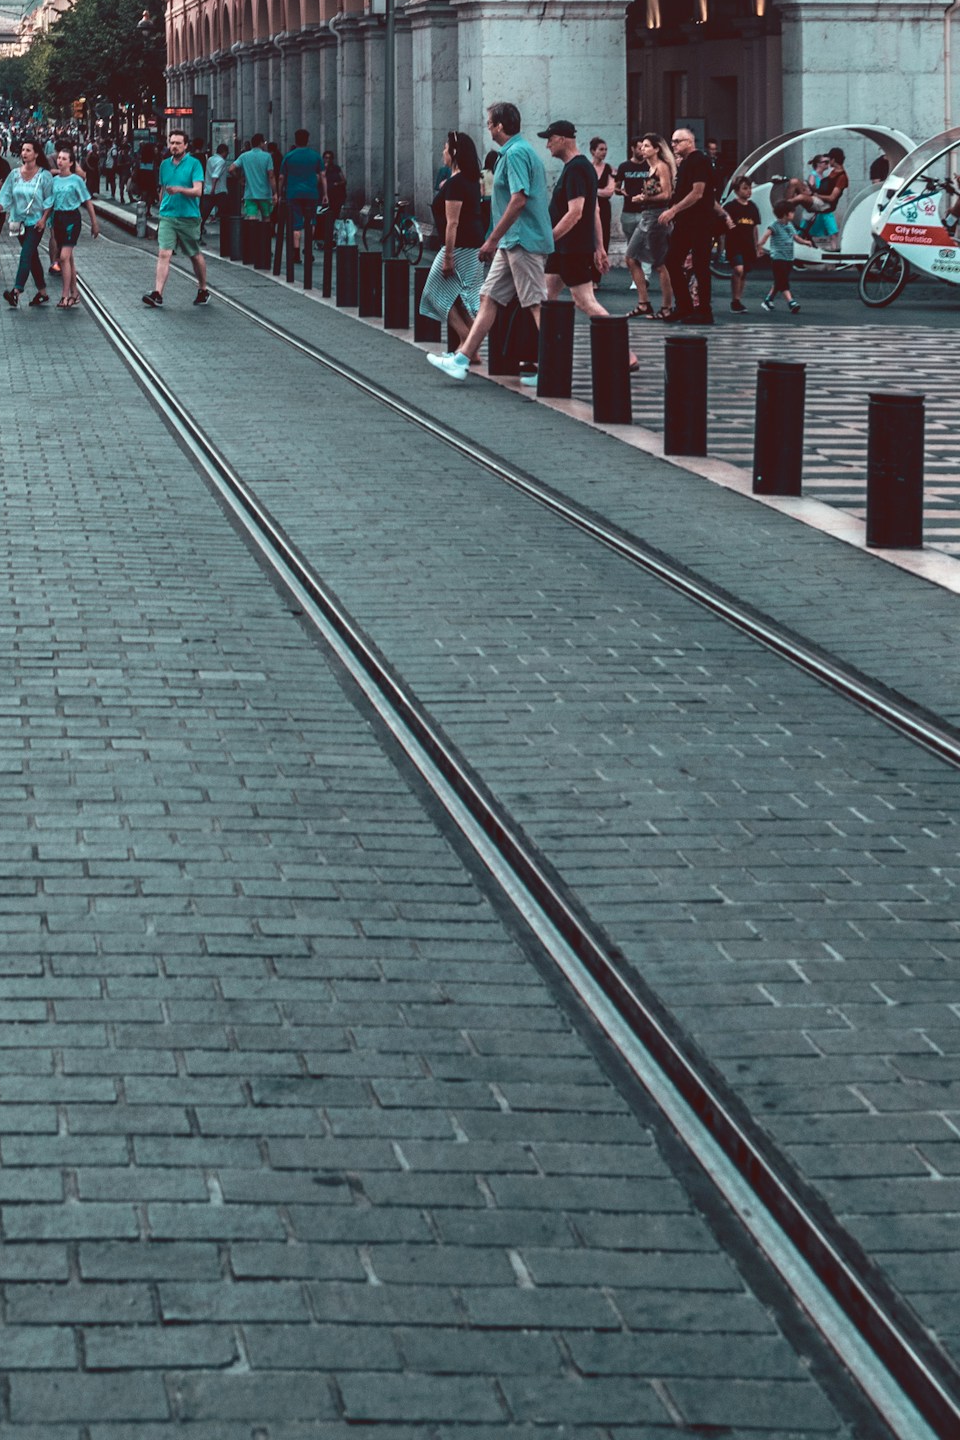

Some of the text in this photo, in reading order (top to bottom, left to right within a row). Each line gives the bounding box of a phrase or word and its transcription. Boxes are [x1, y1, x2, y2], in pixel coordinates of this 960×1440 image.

[925, 204, 936, 212] 60
[906, 211, 918, 219] 30
[895, 226, 927, 235] City tour
[889, 233, 933, 244] Giro turistico
